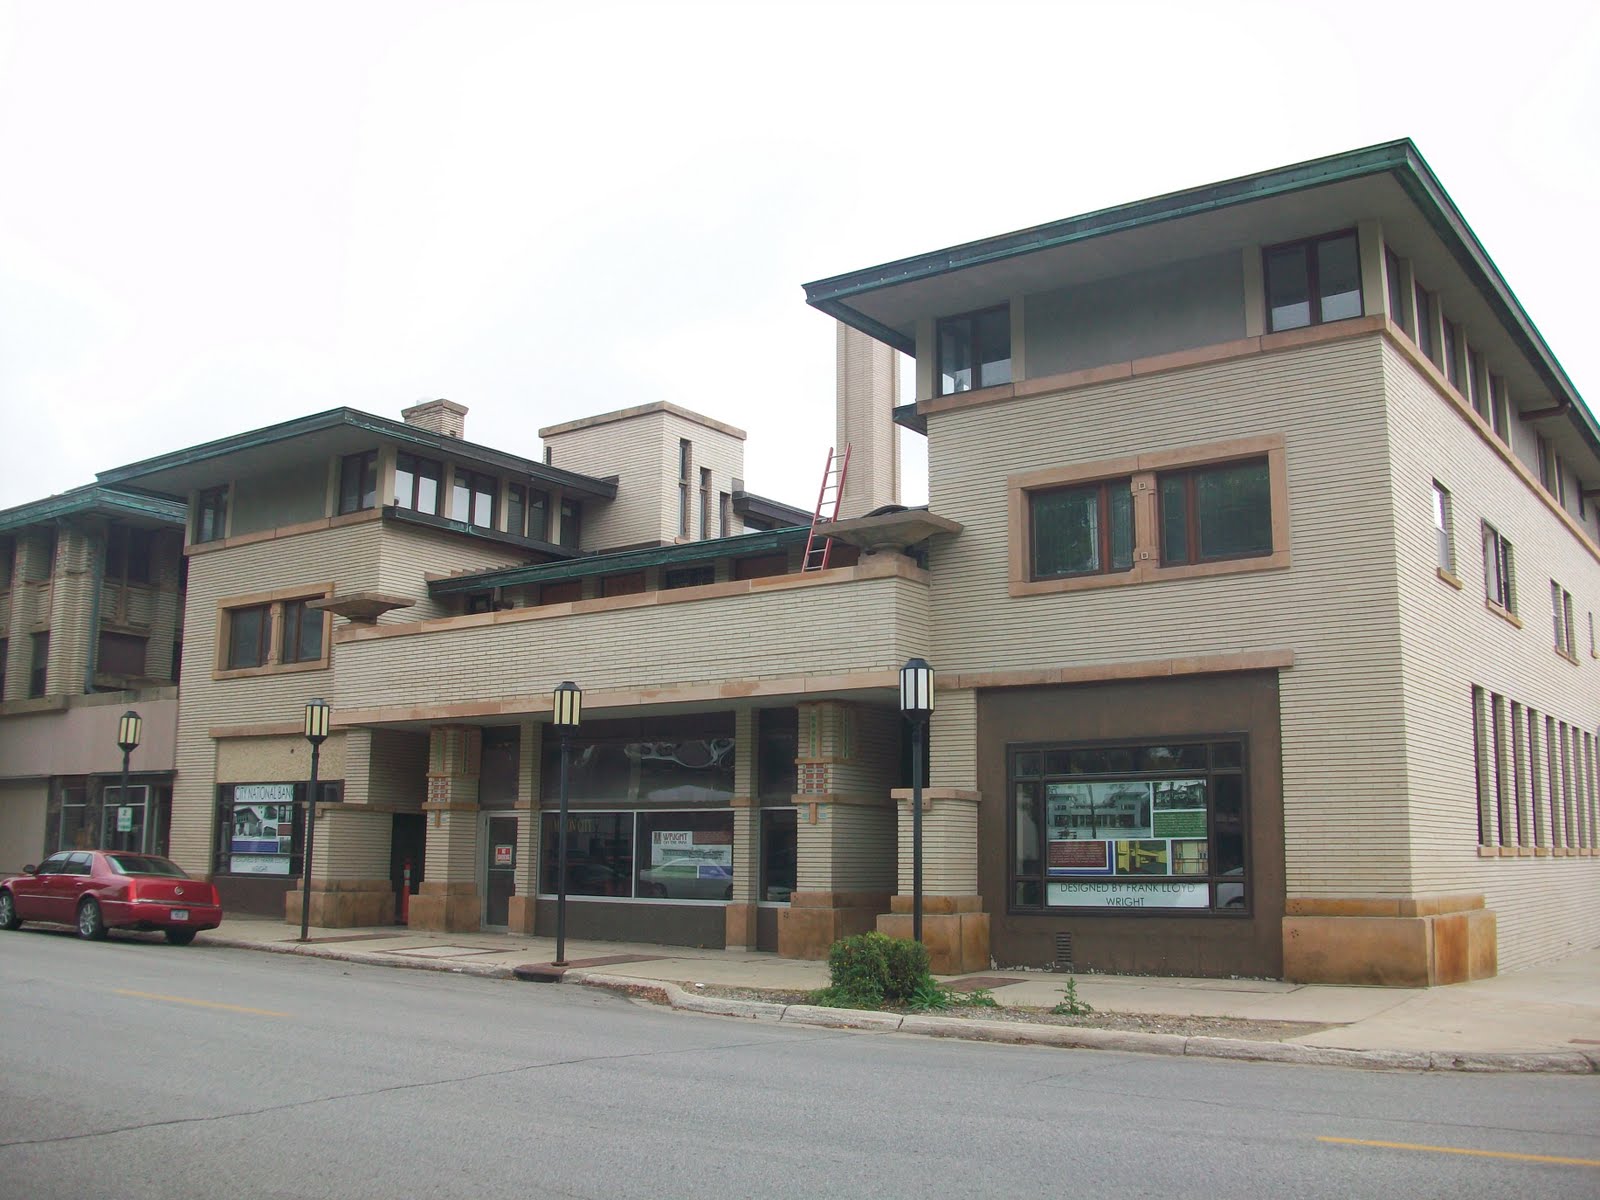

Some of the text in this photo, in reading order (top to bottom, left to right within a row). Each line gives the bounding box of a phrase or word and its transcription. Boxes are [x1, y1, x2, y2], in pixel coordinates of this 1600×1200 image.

[248, 786, 277, 800] NATIONAL
[663, 832, 689, 841] WRIGHT
[1060, 883, 1195, 893] DESIGNED BY FRANK LLOYD
[1106, 897, 1145, 907] WRIGHT
